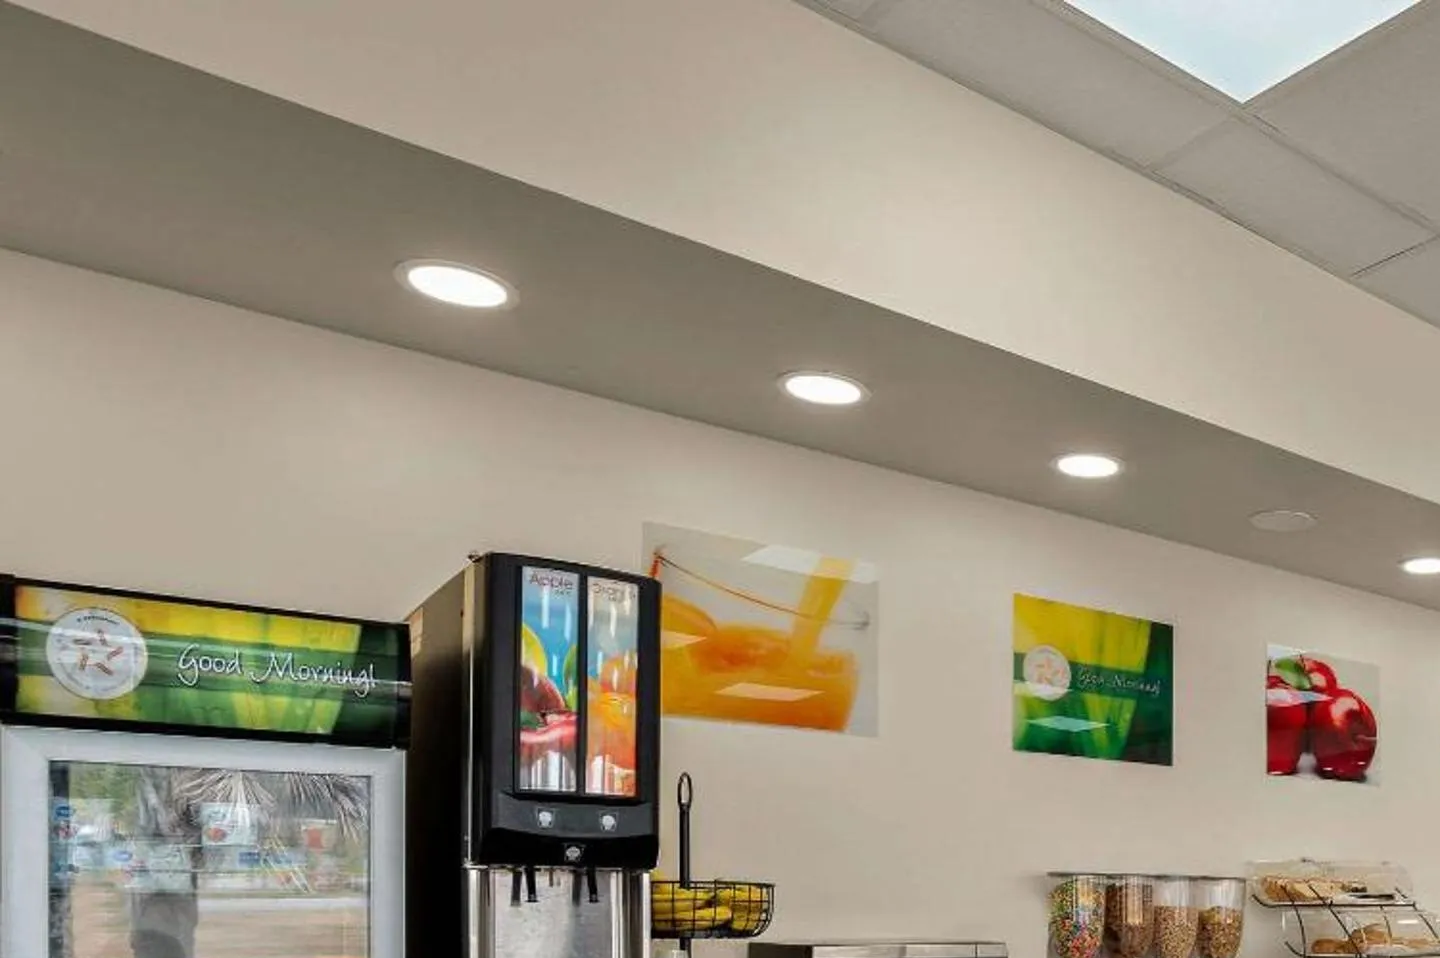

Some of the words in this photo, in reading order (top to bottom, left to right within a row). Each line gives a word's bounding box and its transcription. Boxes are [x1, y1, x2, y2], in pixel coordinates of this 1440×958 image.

[530, 570, 574, 590] Apple
[178, 643, 242, 686] Good
[249, 651, 377, 697] Morning!
